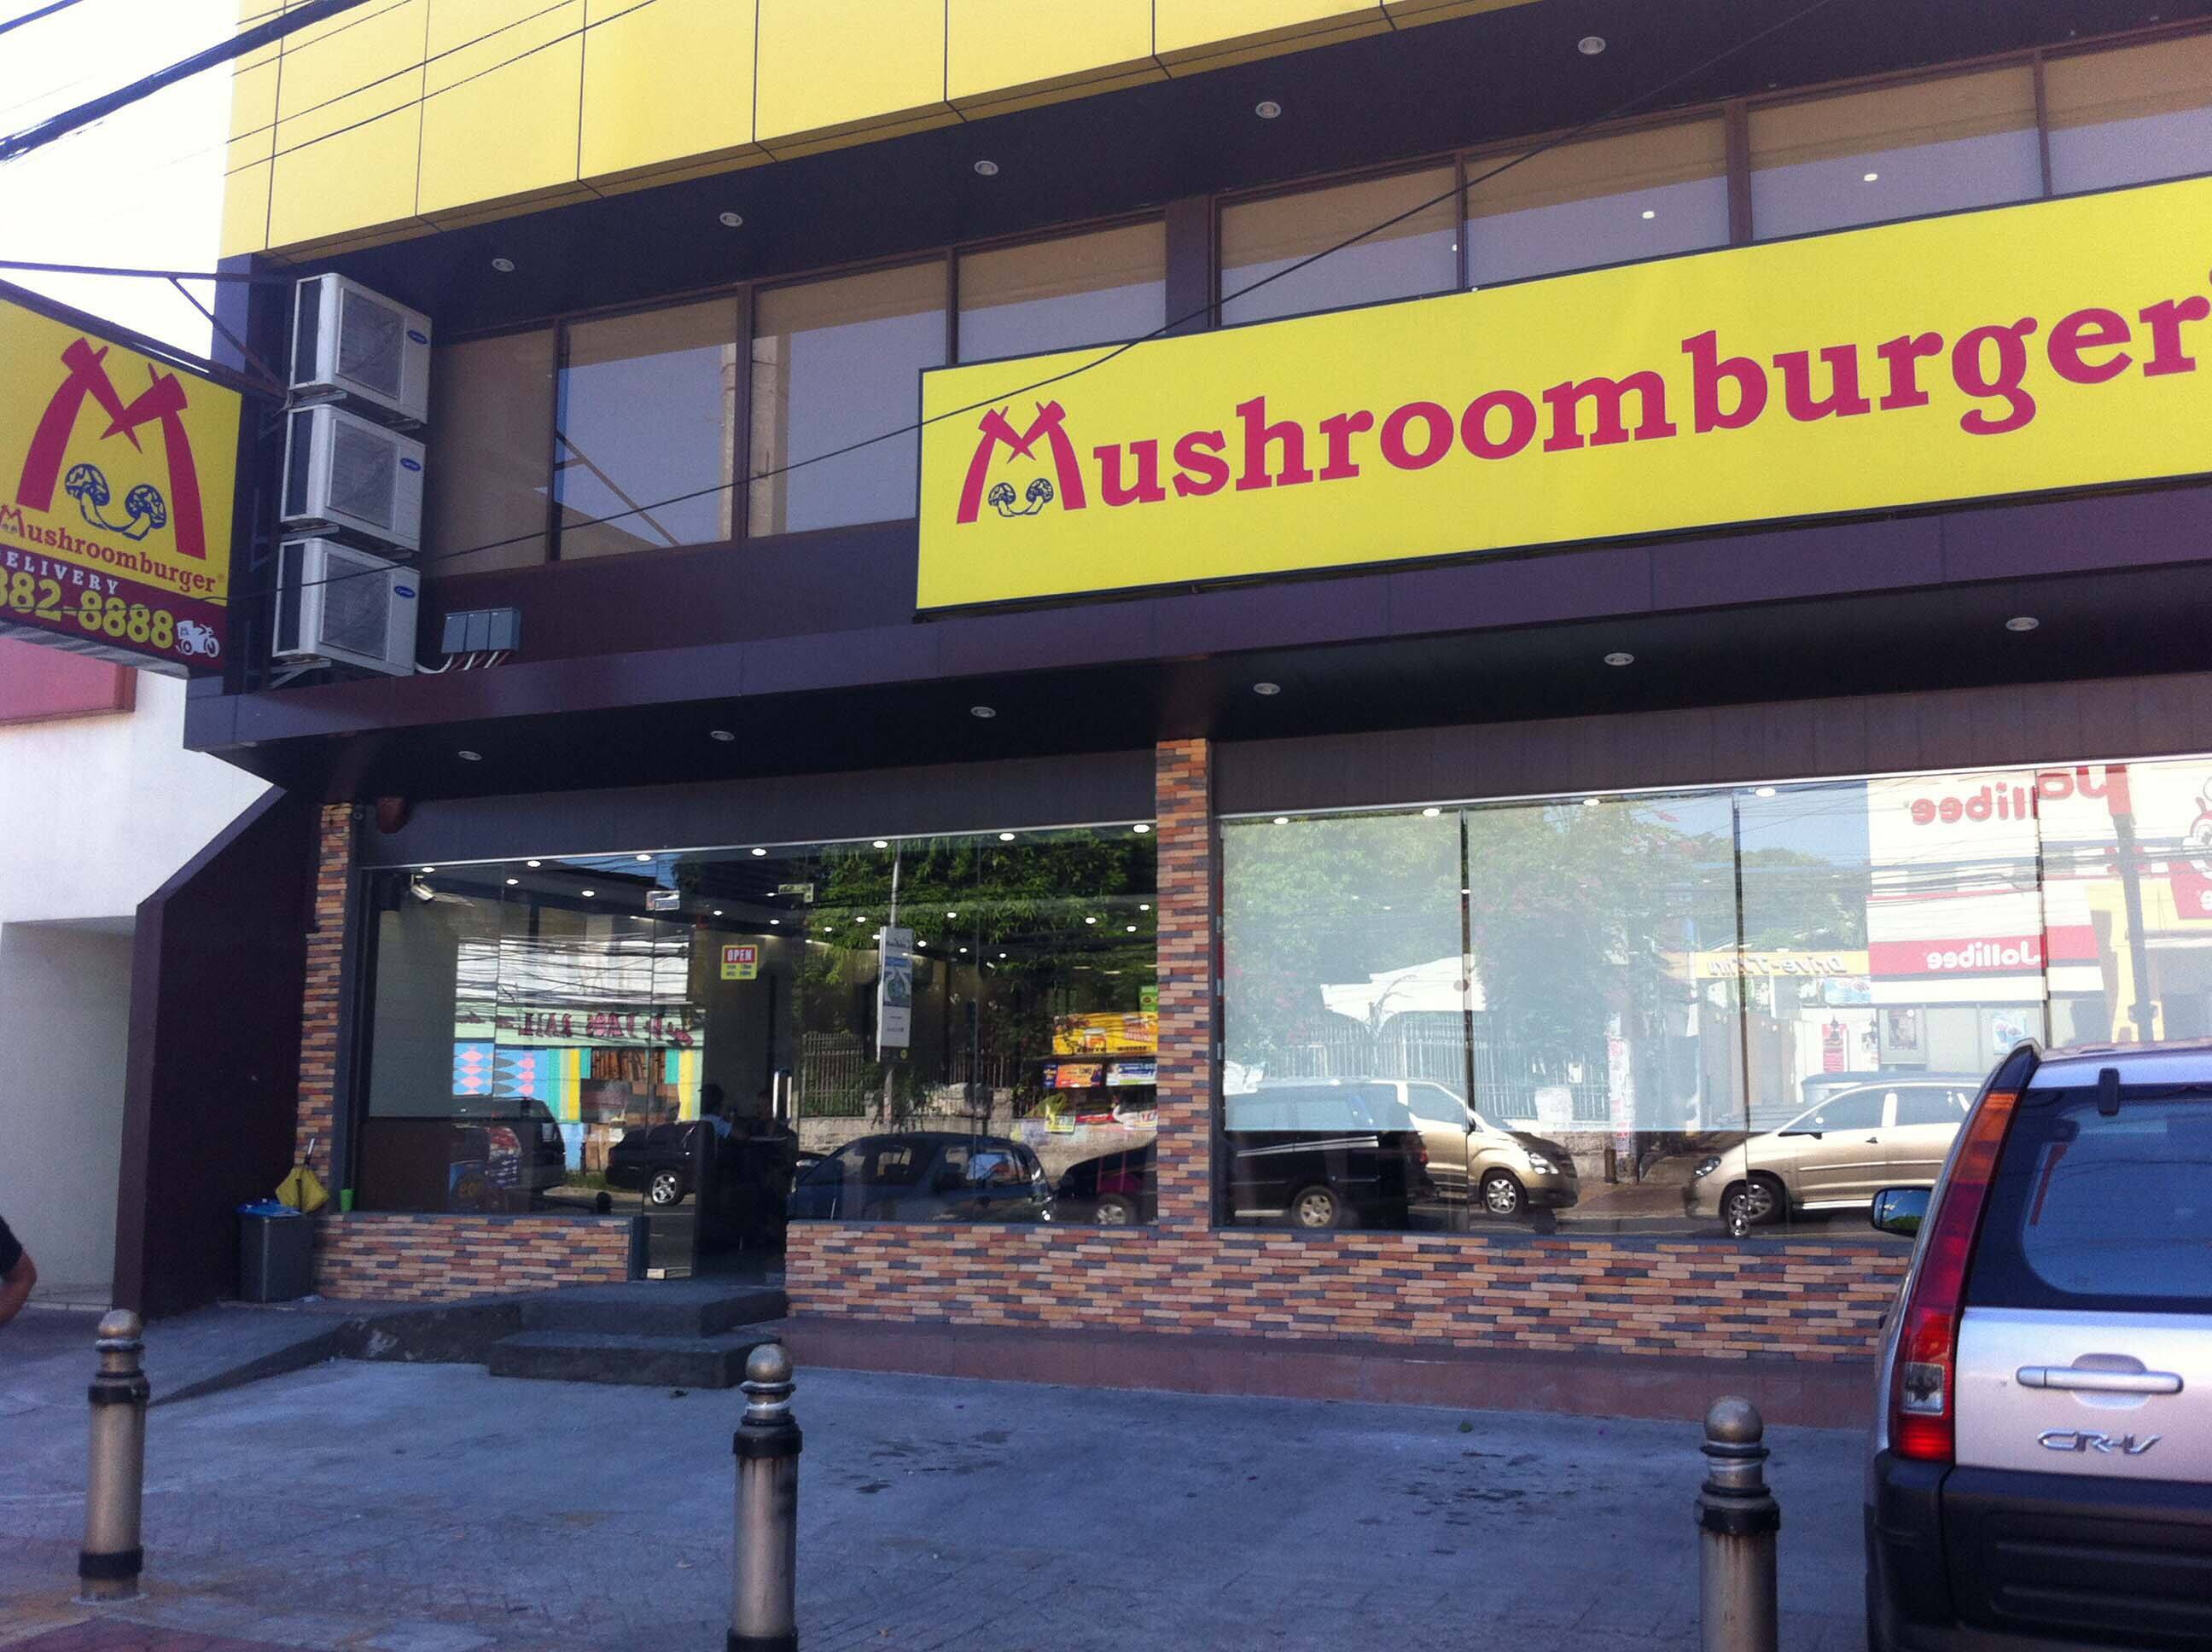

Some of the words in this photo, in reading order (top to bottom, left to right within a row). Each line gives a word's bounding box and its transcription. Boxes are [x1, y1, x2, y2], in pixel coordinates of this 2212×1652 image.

[957, 295, 2211, 524] Mushroomburger
[0, 503, 216, 592] Mushroomburger
[0, 550, 119, 595] ELIVERY
[727, 948, 752, 962] OPEN
